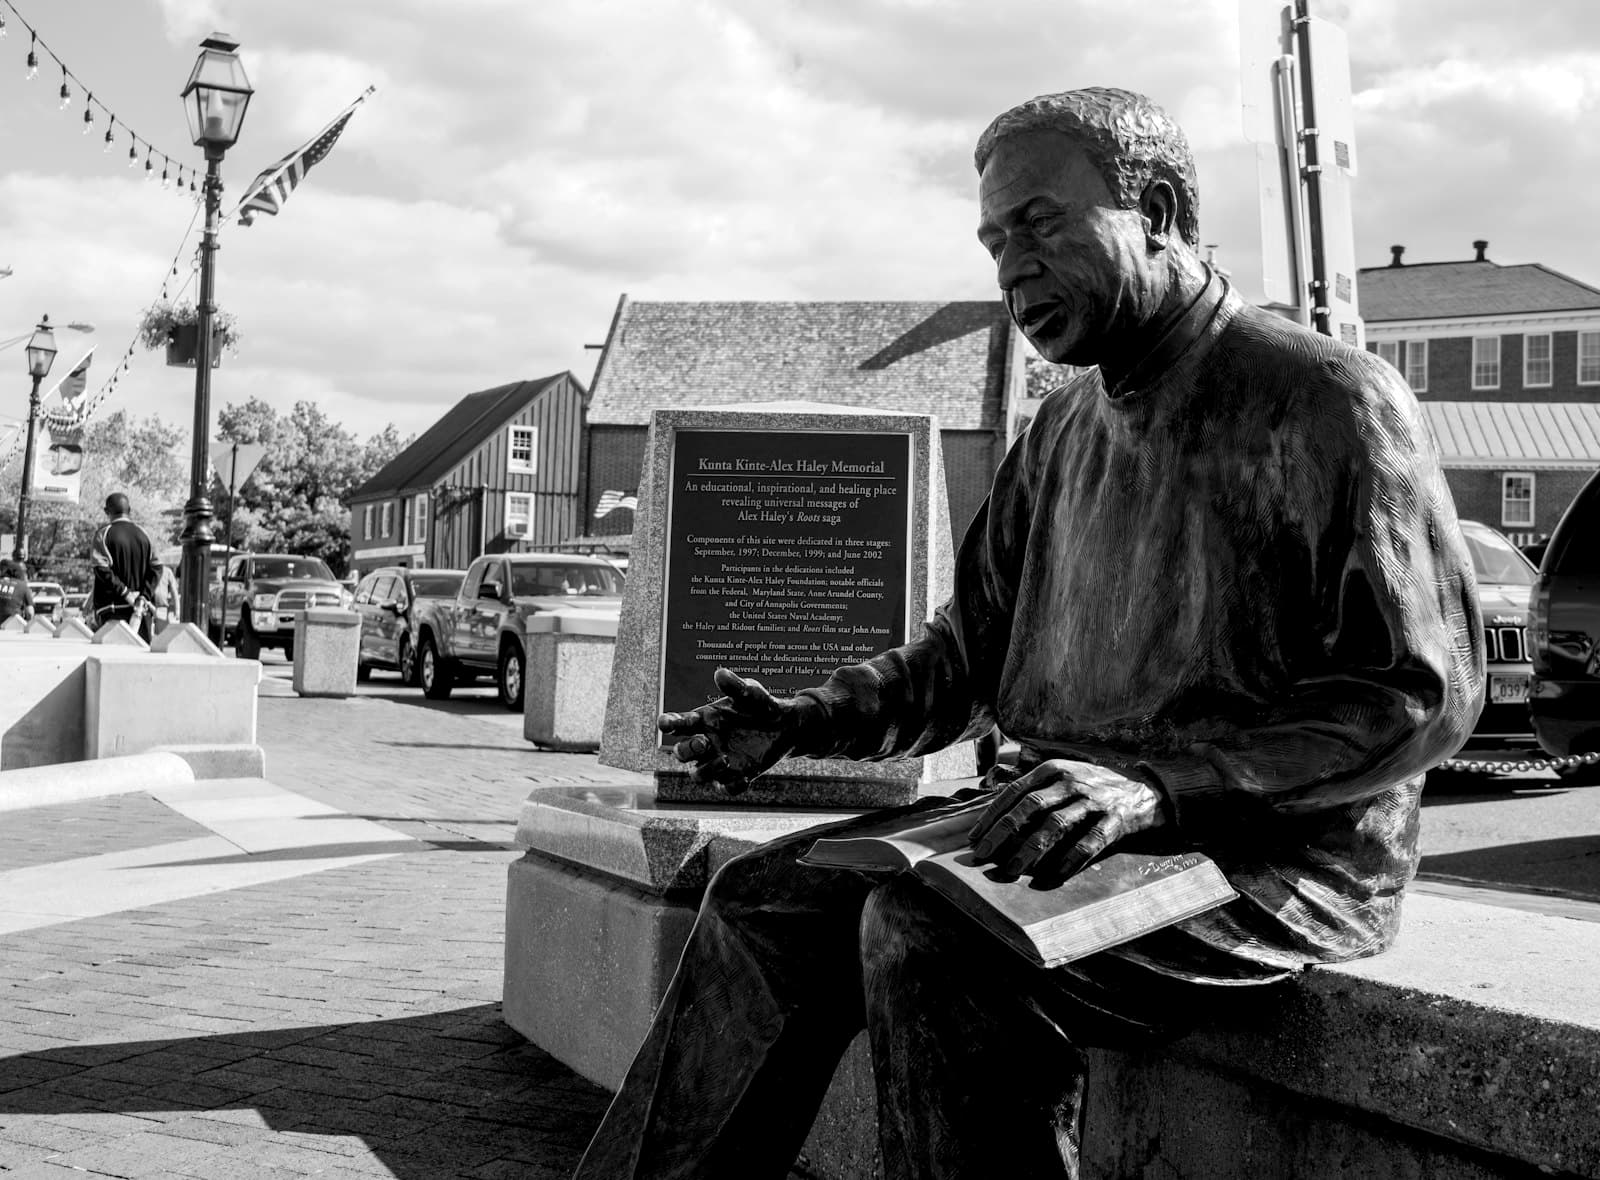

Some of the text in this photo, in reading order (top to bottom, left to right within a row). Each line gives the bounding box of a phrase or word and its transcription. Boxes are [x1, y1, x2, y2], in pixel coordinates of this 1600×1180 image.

[699, 459, 884, 474] Kunta Kinte-Alex Haley Memorial
[684, 481, 897, 497] An educational, inspirational, and healing place
[722, 496, 860, 511] revealing universal messages of
[738, 511, 841, 525] Alex Haley's Roots saga
[687, 535, 734, 546] Components
[737, 536, 745, 544] of
[747, 536, 760, 545] this
[763, 536, 776, 545] site
[797, 537, 833, 546] dedicated
[835, 537, 843, 546] in
[845, 538, 864, 547] three
[866, 539, 892, 550] stages:
[738, 549, 760, 558] 1997;
[762, 548, 801, 558] December,
[804, 550, 825, 559] 1999;
[828, 550, 841, 558] and
[843, 550, 861, 561] June
[863, 551, 882, 559] 2002
[721, 564, 761, 574] Participants
[763, 565, 770, 573] in
[785, 566, 823, 574] dedications
[825, 566, 854, 575] included
[691, 575, 702, 583] the
[704, 576, 724, 584] Kunta
[727, 576, 763, 584] Kinte-Alex
[765, 577, 784, 587] Haley
[830, 578, 855, 586] notable
[857, 578, 884, 587] officials
[690, 587, 706, 595] from
[709, 587, 720, 595] the
[753, 588, 785, 598] Maryland
[827, 590, 854, 598] Arundel
[740, 600, 754, 610] City
[756, 600, 763, 608] of
[763, 600, 799, 610] Annapolis
[801, 601, 848, 611] Governments;
[729, 611, 843, 624] the United States Naval Academy;
[1492, 615, 1522, 624] Jeep
[682, 622, 890, 635] the Haley and Ridout families; and Roots film star John Amos
[697, 640, 734, 649] Thousands
[736, 641, 743, 649] of
[745, 642, 767, 652] people
[769, 642, 785, 650] from
[810, 643, 821, 651] the
[823, 643, 839, 652] USA
[841, 644, 853, 652] and
[855, 644, 874, 652] other
[696, 653, 727, 661] countries
[729, 653, 758, 661] attended
[761, 654, 771, 662] the
[773, 654, 812, 663] dedications
[814, 655, 839, 665] thereby
[762, 666, 783, 676] appeal
[785, 666, 793, 674] of
[795, 666, 819, 677] Haley's
